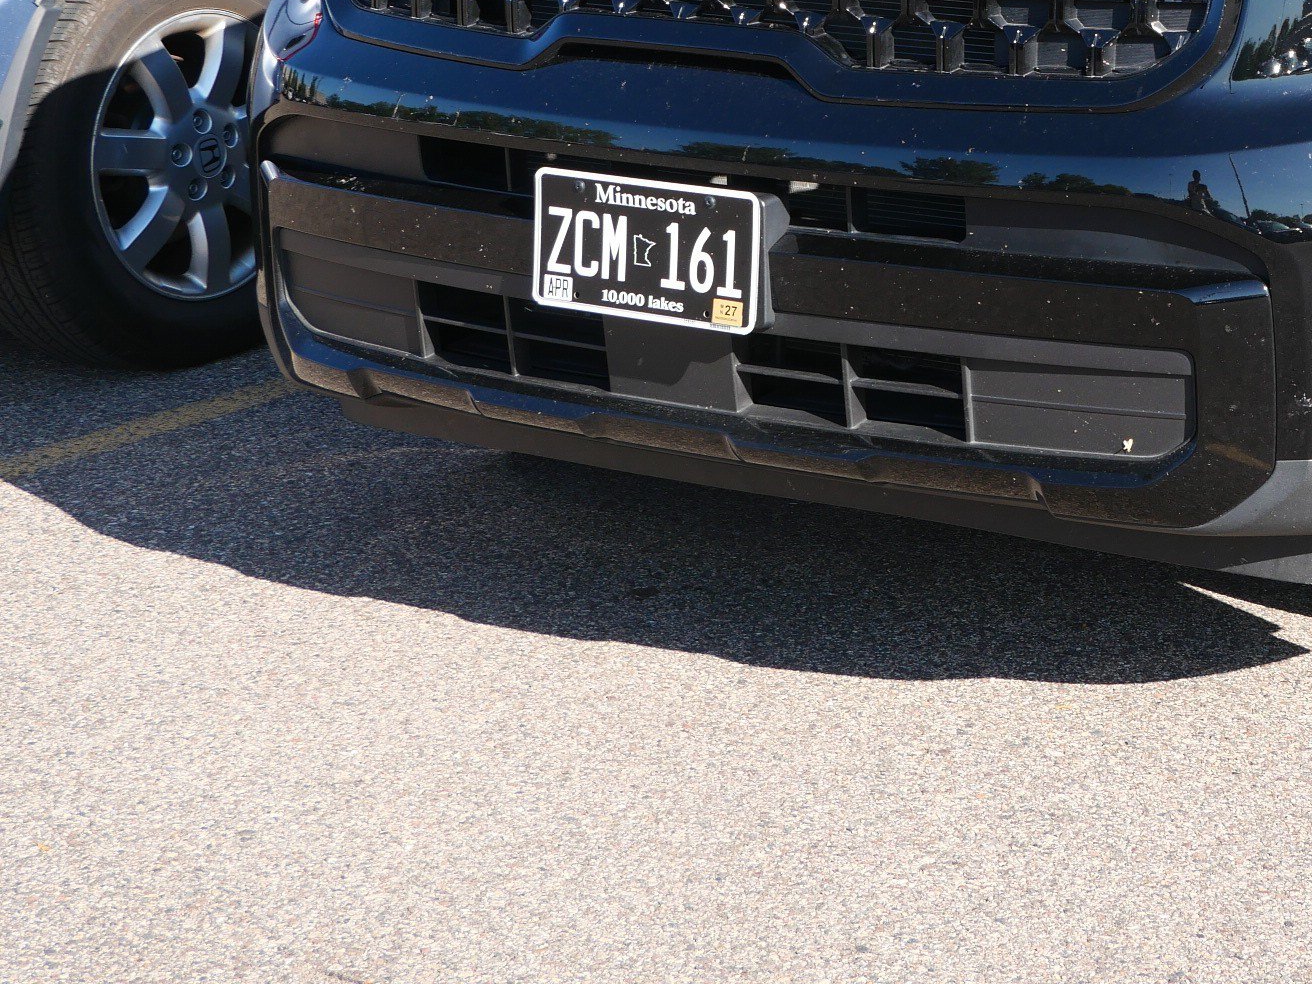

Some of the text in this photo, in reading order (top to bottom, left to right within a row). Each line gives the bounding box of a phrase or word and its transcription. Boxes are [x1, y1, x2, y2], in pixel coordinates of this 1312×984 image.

[595, 183, 696, 215] Minnesota
[547, 206, 742, 299] ZCM 161
[548, 277, 569, 298] APR
[601, 289, 684, 313] 10,000 lakes
[725, 304, 737, 316] 27
